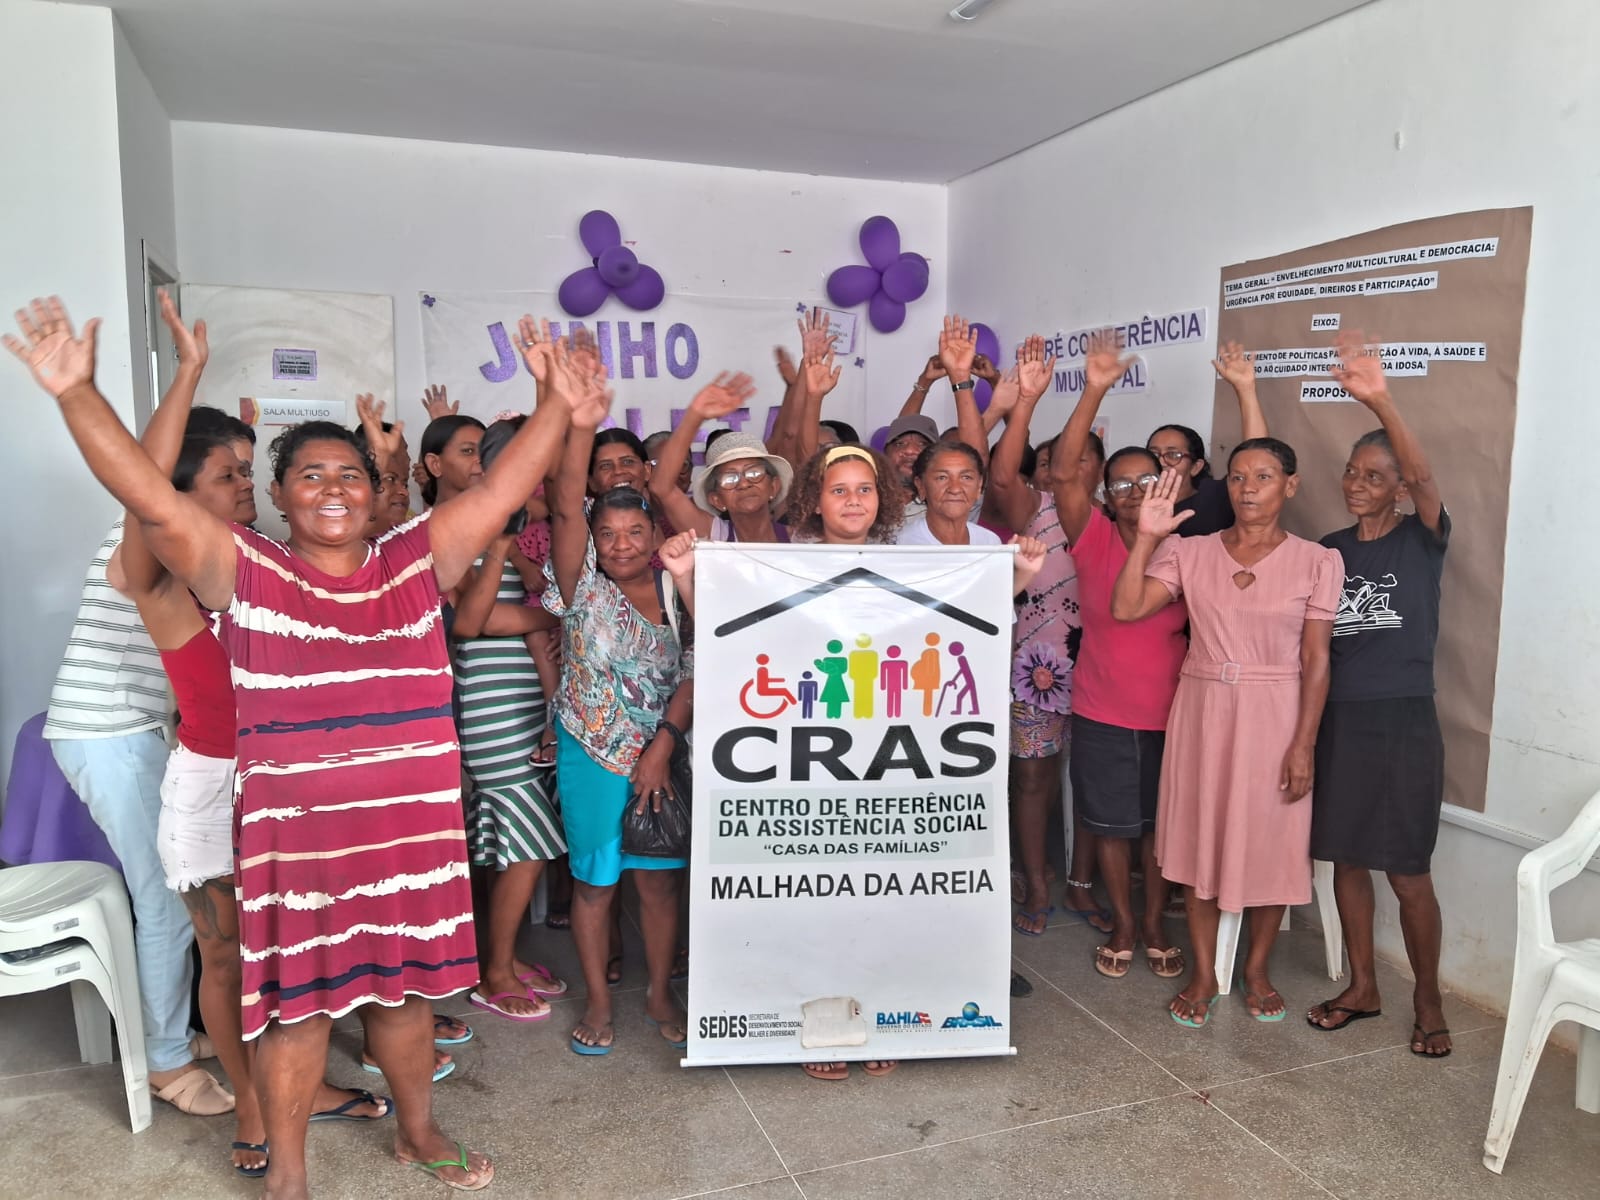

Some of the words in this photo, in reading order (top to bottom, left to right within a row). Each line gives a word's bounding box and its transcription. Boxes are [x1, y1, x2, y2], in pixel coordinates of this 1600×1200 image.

[1225, 283, 1243, 293] TEMA
[1244, 278, 1270, 289] GERAL:
[1276, 263, 1344, 282] ENVELHECIMENTO
[1346, 252, 1418, 269] MULTICULTURAL
[1419, 249, 1426, 258] E
[1428, 242, 1495, 257] DEMOCRACIA:
[1226, 294, 1259, 308] URGÊNCIA
[1260, 292, 1275, 302] POR
[1277, 286, 1317, 299] EQUIDADE,
[1320, 283, 1356, 294] DIREIROS
[1358, 283, 1364, 292] E
[1042, 332, 1065, 361] RÉ
[1278, 351, 1287, 360] DE
[1288, 350, 1328, 360] POLÍTICAS
[1408, 347, 1432, 357] VIDA,
[1443, 345, 1476, 356] SAÚDE
[1479, 347, 1485, 356] E
[1055, 364, 1146, 393] MUNAL
[1274, 364, 1308, 373] CUIDADO
[263, 407, 286, 416] SALA
[287, 408, 330, 417] MULTIUSO
[711, 721, 997, 783] CRAS
[720, 798, 811, 817] CENTRO
[819, 798, 847, 816] DE
[856, 791, 987, 815] REFERÊNCIA
[719, 820, 750, 837] DA
[757, 814, 906, 837] ASSISTÊNCIA
[914, 813, 988, 835] SOCIAL
[824, 843, 859, 855] DAS
[711, 873, 855, 899] MALHADA
[864, 872, 905, 896] DA
[910, 868, 994, 896] AREIA
[699, 1015, 748, 1039] SEDES
[876, 1011, 923, 1024] BAHIA
